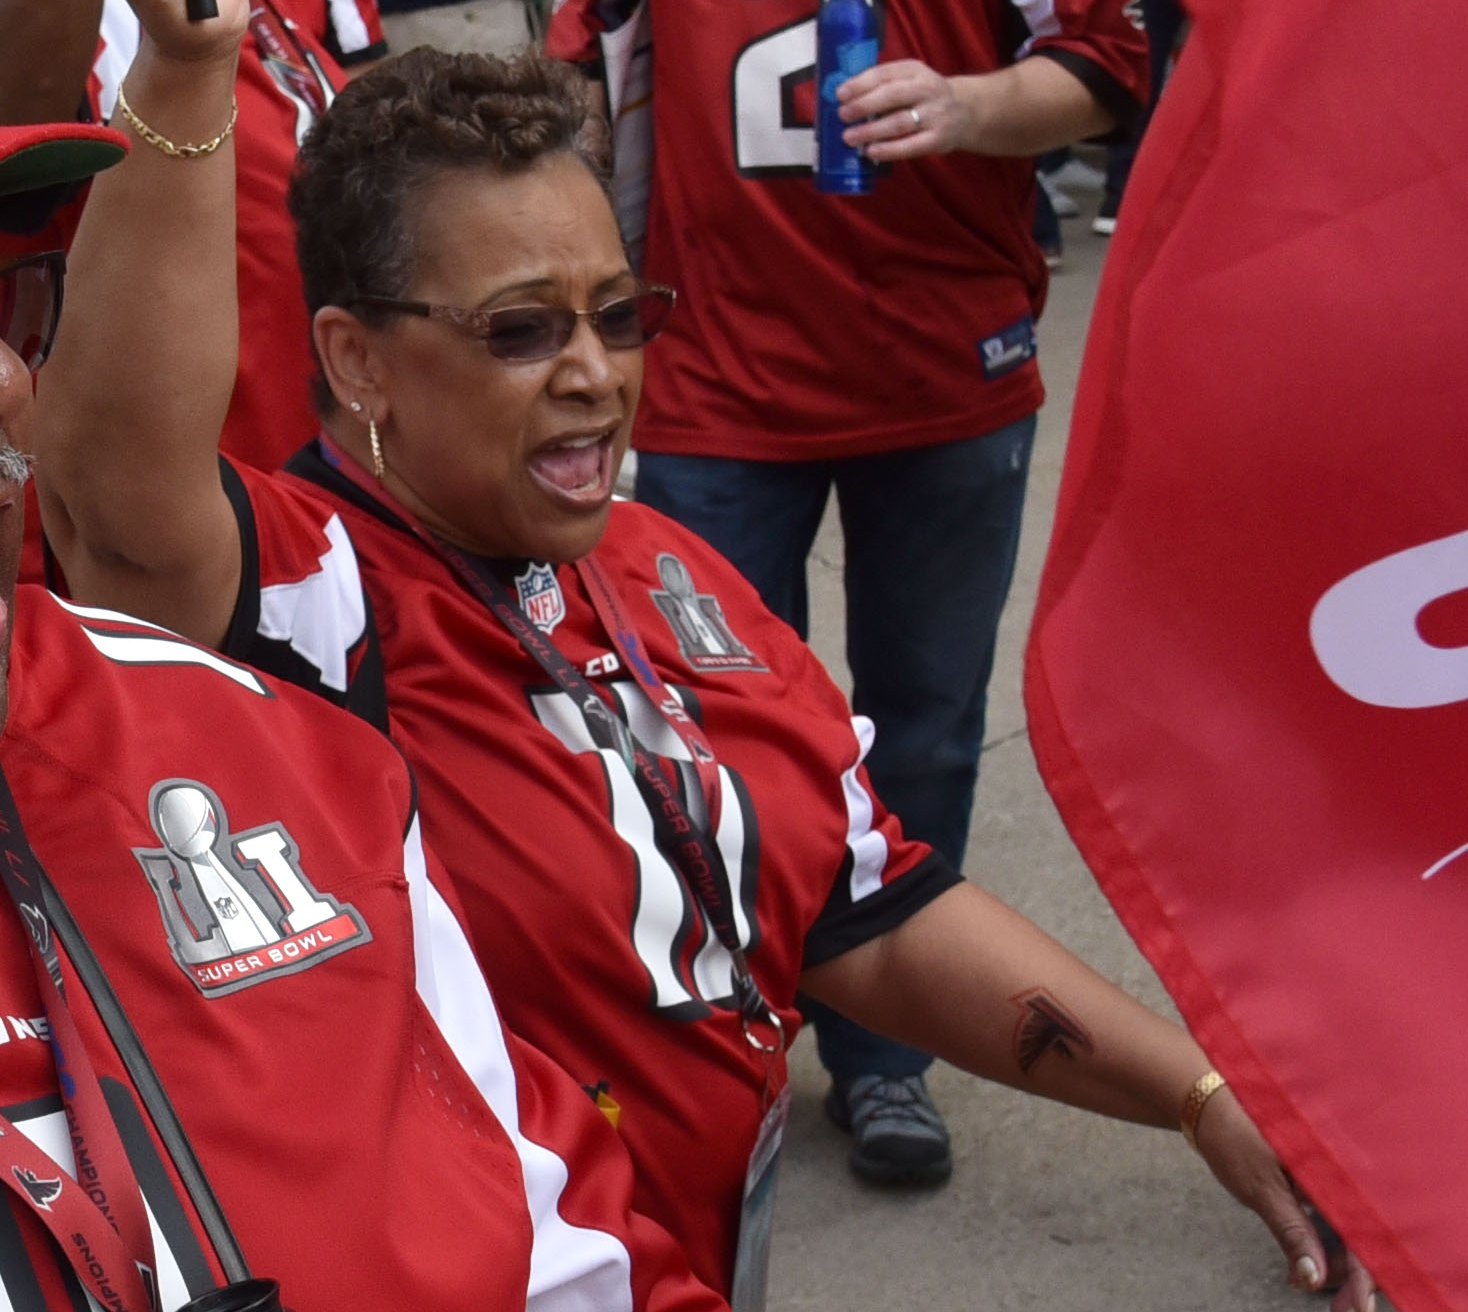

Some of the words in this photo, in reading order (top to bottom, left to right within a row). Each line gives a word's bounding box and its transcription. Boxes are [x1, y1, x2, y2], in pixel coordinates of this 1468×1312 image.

[525, 590, 560, 624] NFL
[196, 955, 264, 982] SUPER
[267, 929, 333, 962] BOWL
